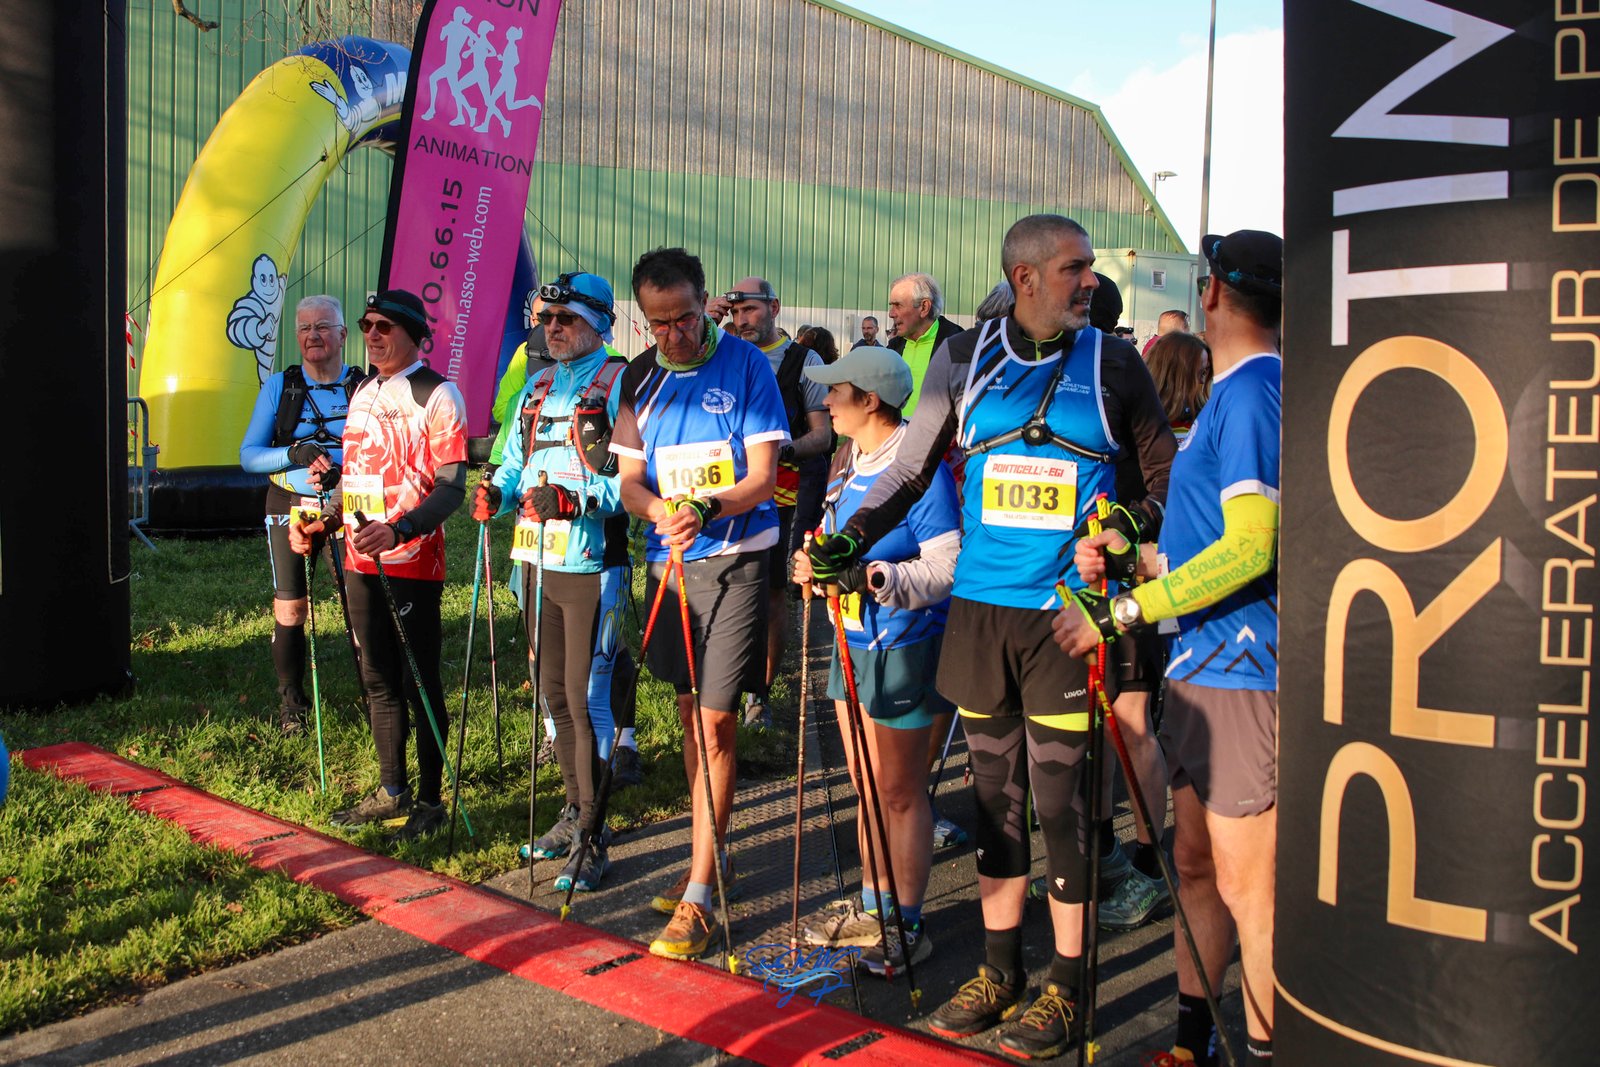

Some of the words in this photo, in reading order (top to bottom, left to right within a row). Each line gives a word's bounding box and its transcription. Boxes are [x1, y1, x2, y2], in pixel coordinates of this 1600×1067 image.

[414, 135, 532, 176] ANIMATION
[1552, 117, 1600, 232] DE
[441, 186, 492, 382] imation.asso-web.com
[668, 465, 722, 489] 1036
[994, 482, 1059, 511] 1033
[344, 494, 372, 512] 001
[1529, 269, 1600, 954] ACCELERATEUR
